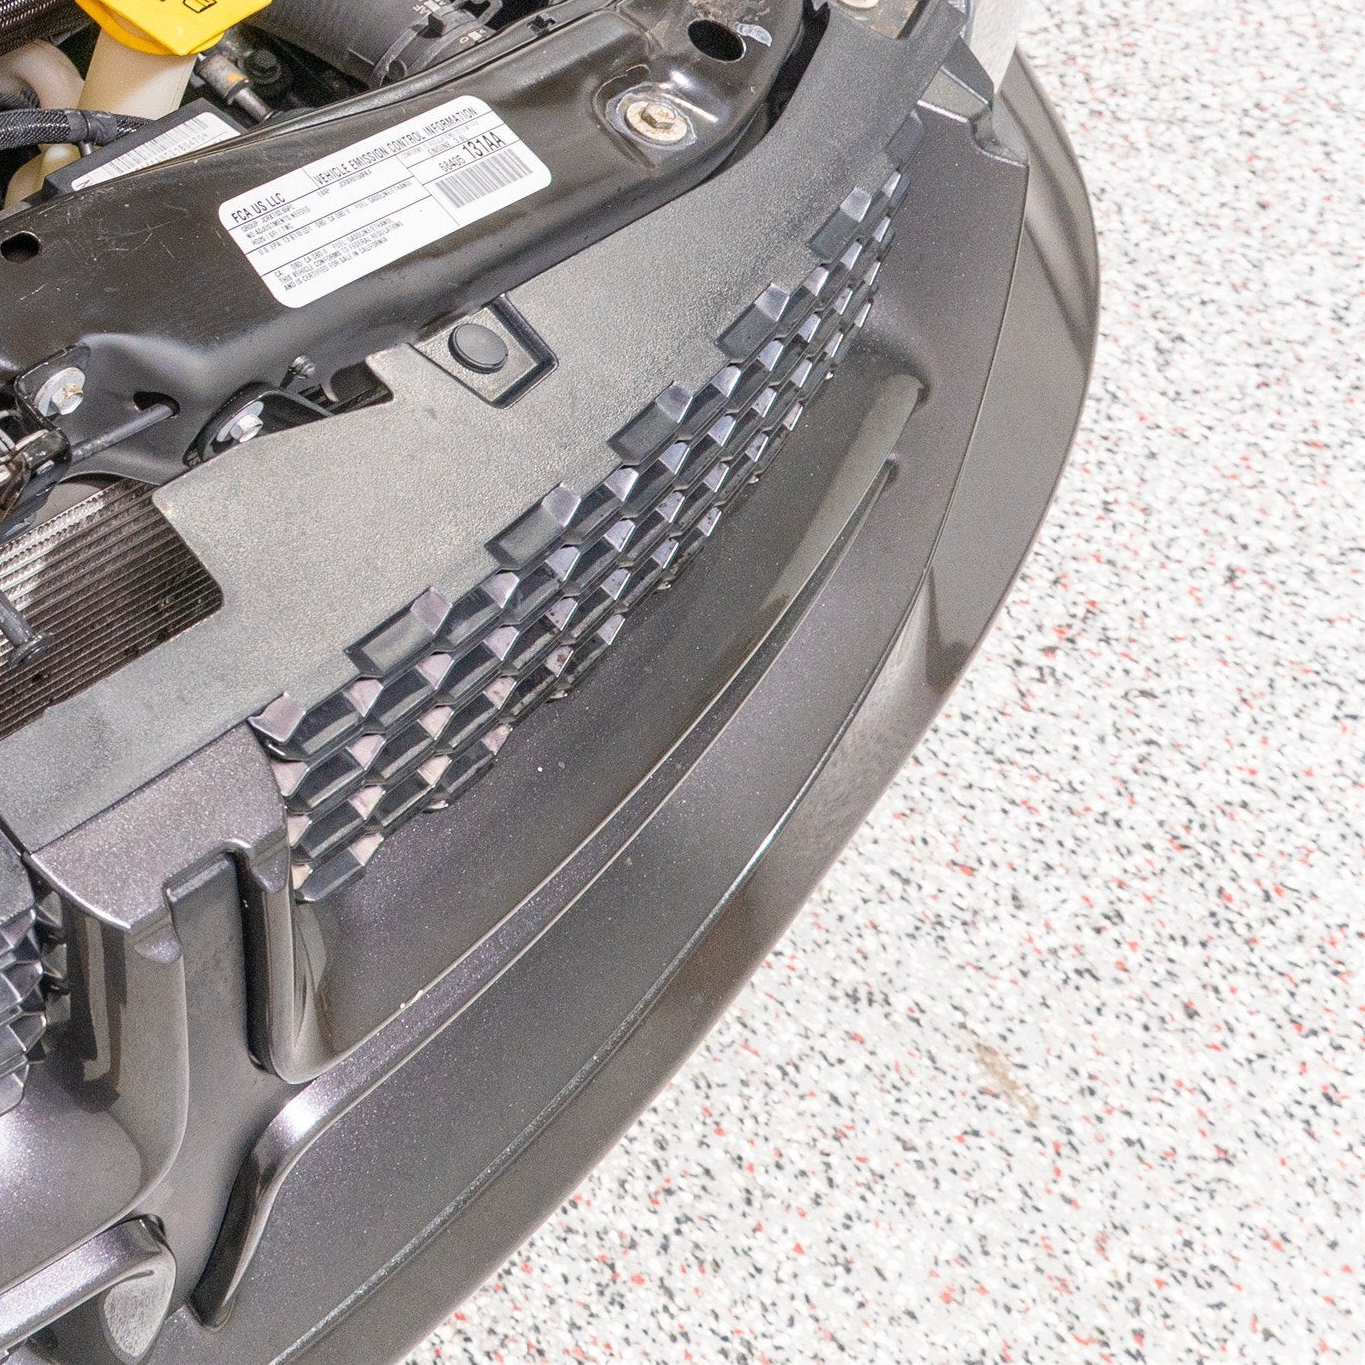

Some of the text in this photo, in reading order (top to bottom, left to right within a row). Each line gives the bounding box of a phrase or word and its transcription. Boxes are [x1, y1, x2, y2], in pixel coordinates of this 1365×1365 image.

[312, 162, 351, 185] VEHICLE
[347, 145, 390, 170] EMISSION
[385, 129, 426, 153] CONTROL
[421, 106, 478, 136] INFORMATION
[459, 130, 506, 160] 131AA
[230, 191, 286, 223] FCA US LLC
